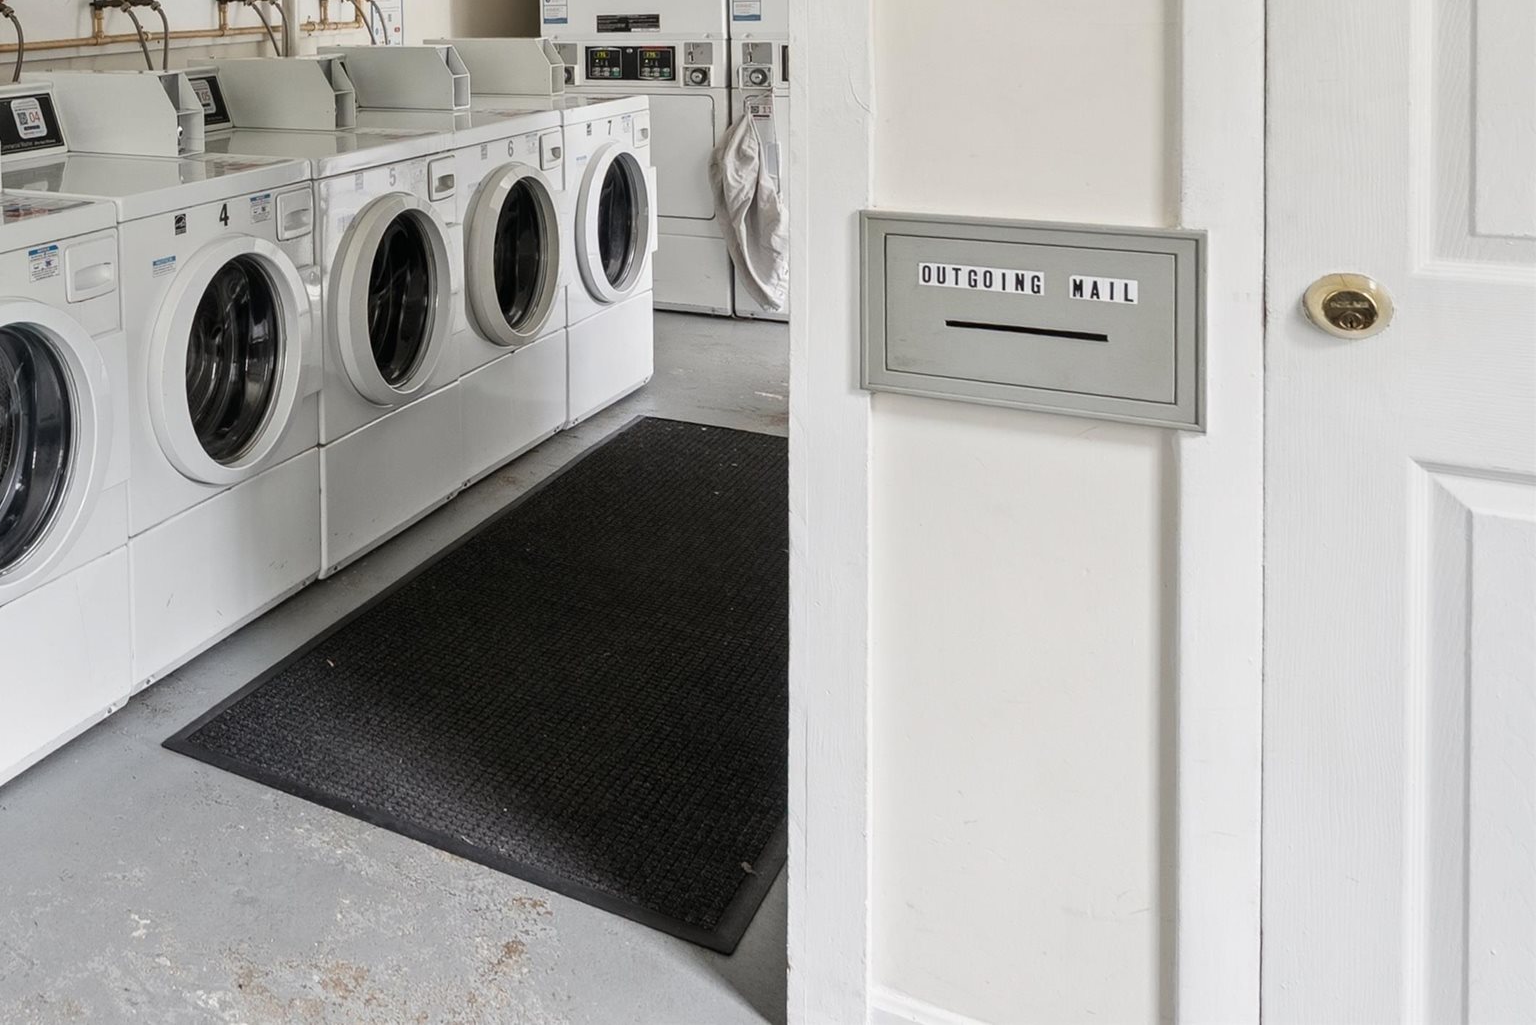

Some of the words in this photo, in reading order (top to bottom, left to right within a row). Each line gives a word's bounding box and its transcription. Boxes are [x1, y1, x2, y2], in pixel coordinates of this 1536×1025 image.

[201, 91, 211, 101] 05
[29, 111, 41, 123] 04
[607, 120, 612, 136] 7
[507, 140, 514, 158] 6
[389, 167, 397, 187] 5
[219, 203, 229, 227] 4
[921, 264, 1042, 295] OUTGOING
[1072, 278, 1135, 302] MAIL
